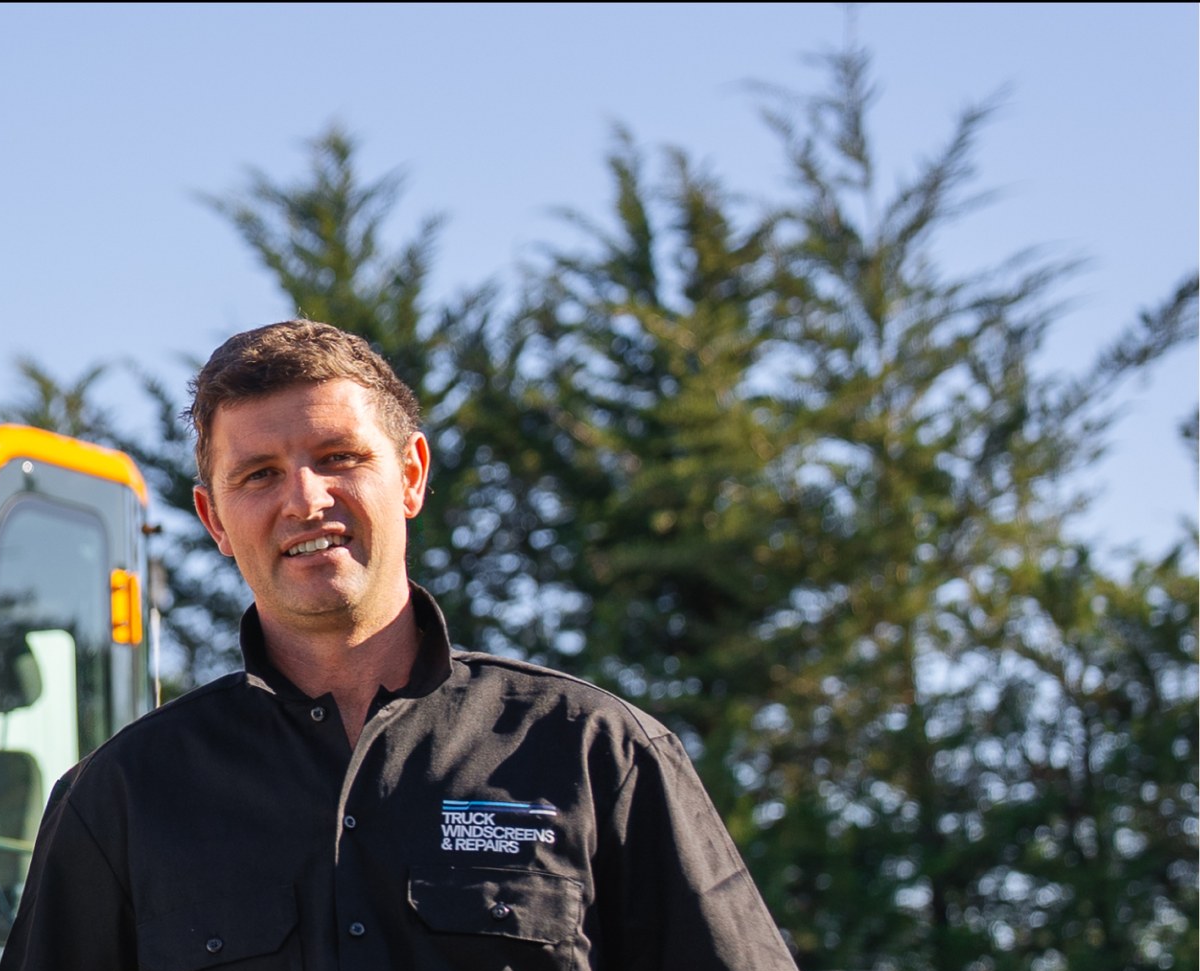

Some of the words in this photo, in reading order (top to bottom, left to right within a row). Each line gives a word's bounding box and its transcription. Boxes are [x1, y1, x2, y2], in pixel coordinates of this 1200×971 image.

[441, 811, 496, 826] TRUCK
[440, 824, 556, 844] WINDSCREENS
[441, 837, 453, 851] &
[454, 838, 520, 854] REPAIRS
